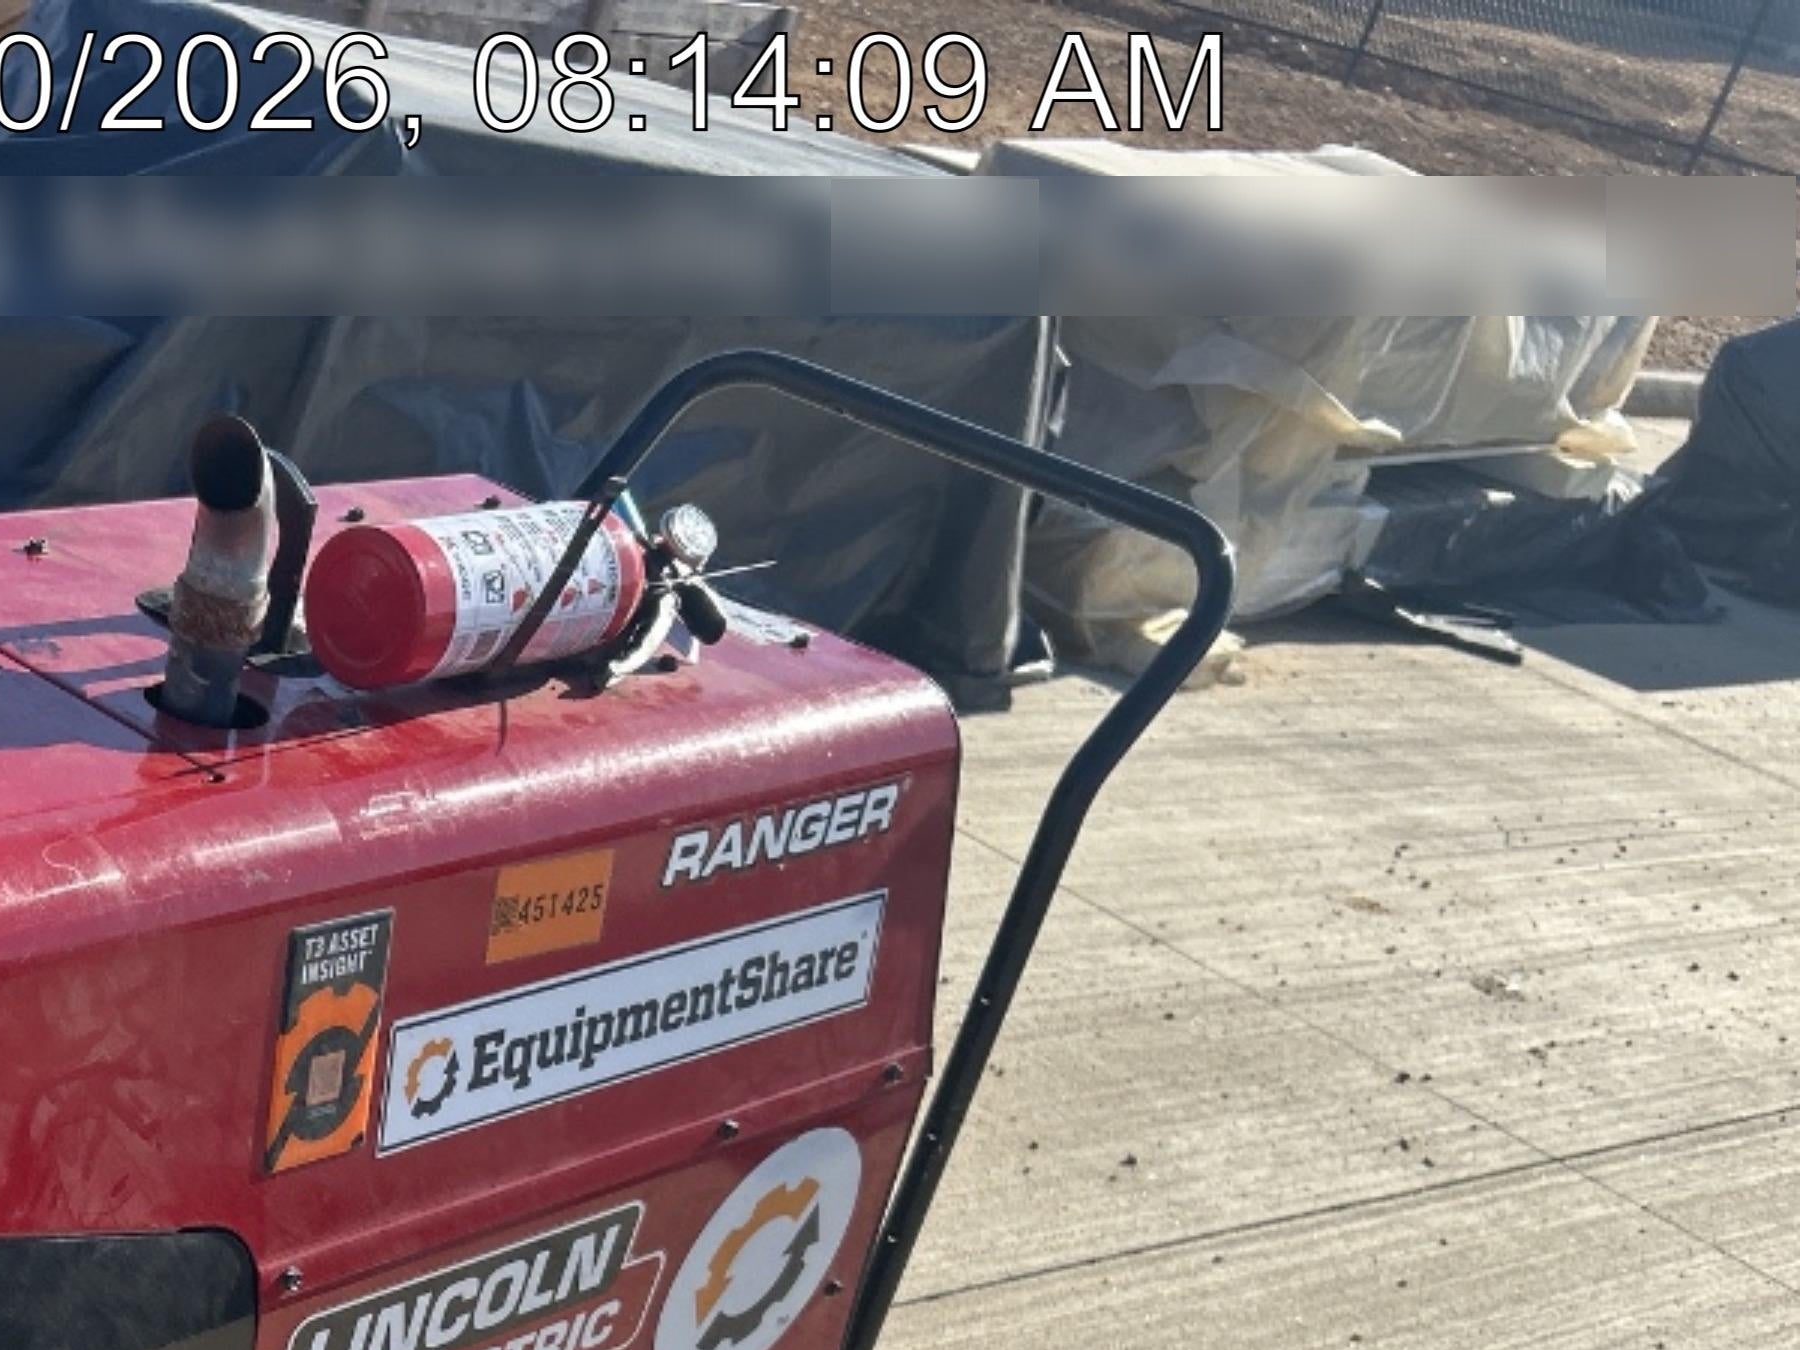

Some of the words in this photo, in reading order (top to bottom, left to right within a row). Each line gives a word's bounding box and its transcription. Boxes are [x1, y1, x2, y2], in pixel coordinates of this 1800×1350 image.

[661, 784, 898, 887] RANGER
[518, 884, 603, 924] 451425
[327, 923, 379, 955] ASSET
[302, 950, 366, 985] INSIGHT
[467, 940, 859, 1091] EquipmentShare
